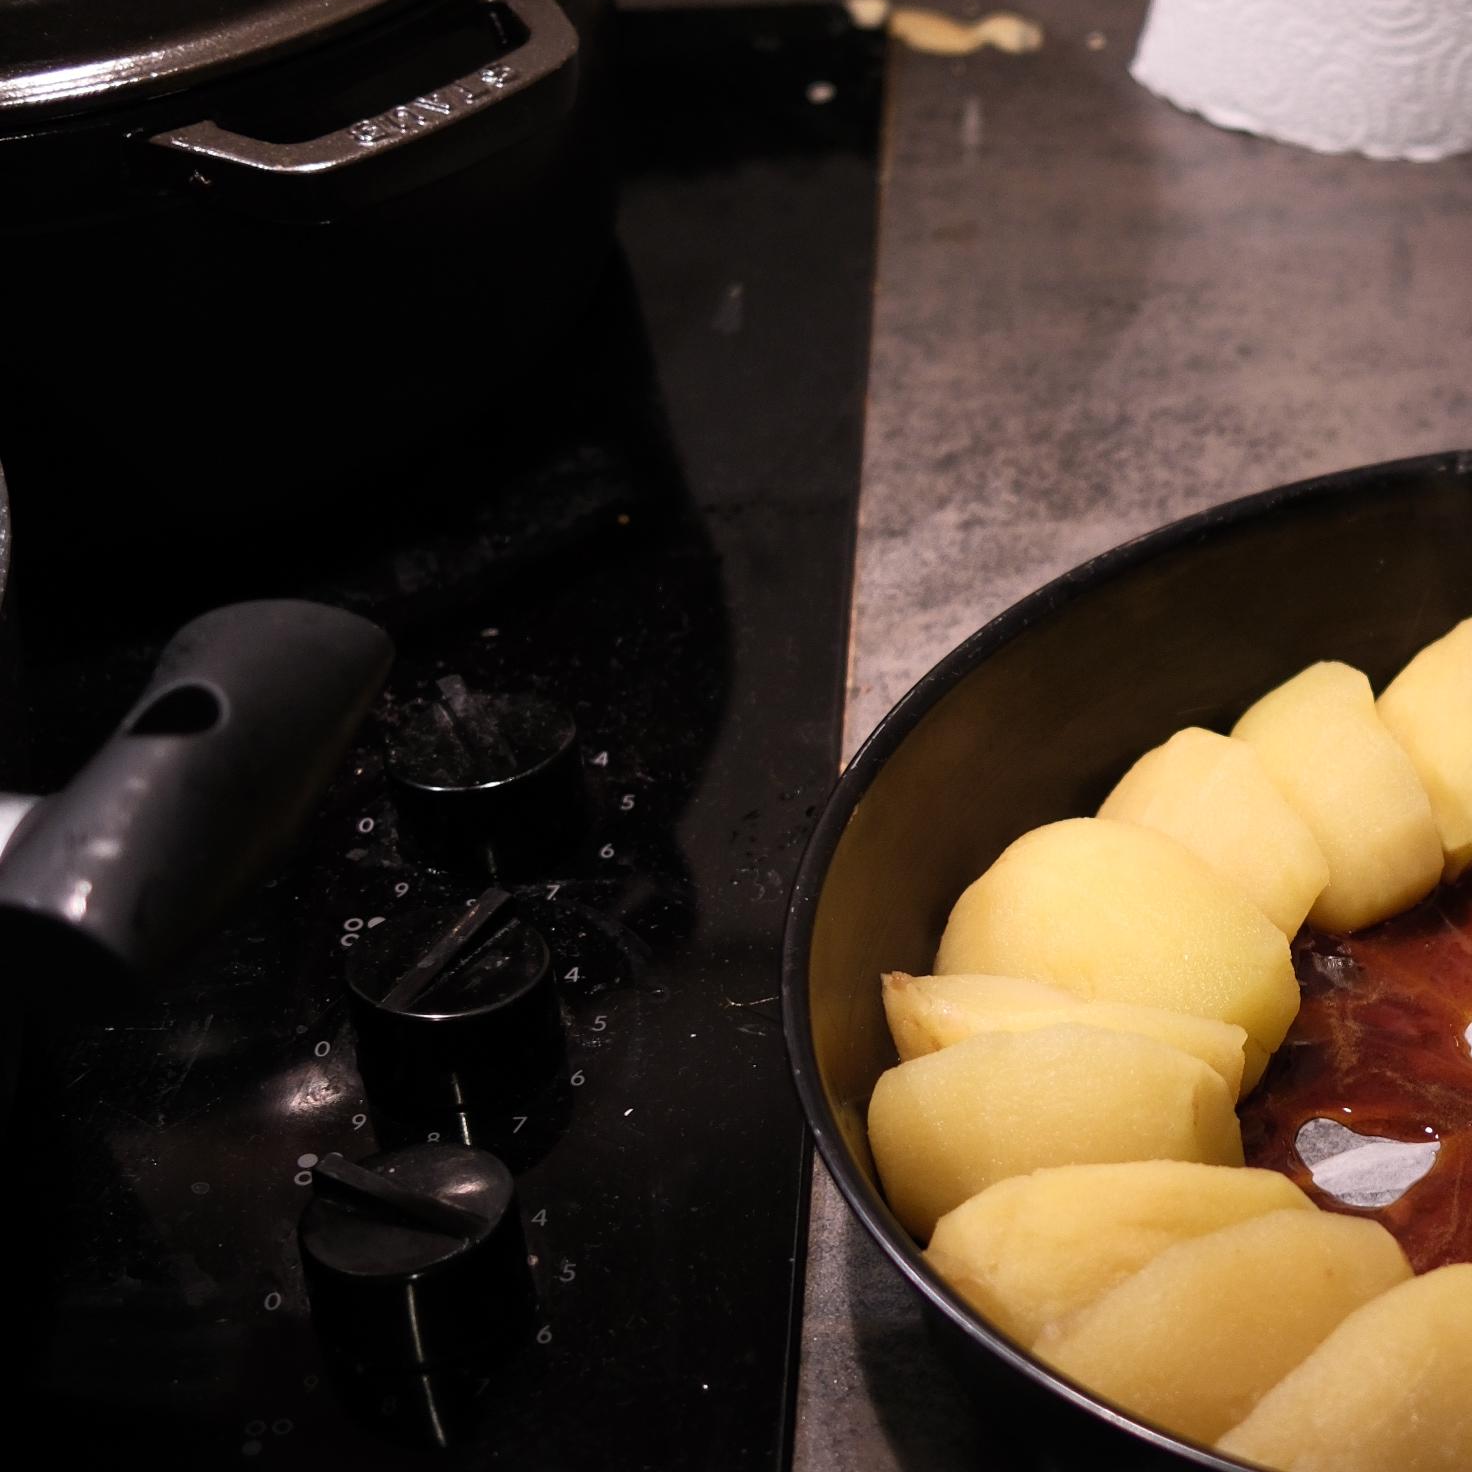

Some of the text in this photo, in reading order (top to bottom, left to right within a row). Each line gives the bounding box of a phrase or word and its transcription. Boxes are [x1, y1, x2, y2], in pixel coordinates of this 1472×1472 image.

[592, 751, 609, 767] 4
[620, 794, 636, 811] 5
[357, 817, 375, 834] 0
[599, 843, 615, 859] 6
[394, 881, 410, 898] 9
[546, 884, 562, 901] 7
[564, 966, 581, 983] 4
[591, 1015, 608, 1032] 5
[313, 1040, 331, 1058] 0
[570, 1069, 586, 1087] 6
[351, 1113, 367, 1131] 9
[512, 1115, 529, 1134] 7
[530, 1208, 548, 1227] 4
[558, 1263, 577, 1283] 5
[263, 1291, 282, 1311] 0
[536, 1324, 553, 1344] 6
